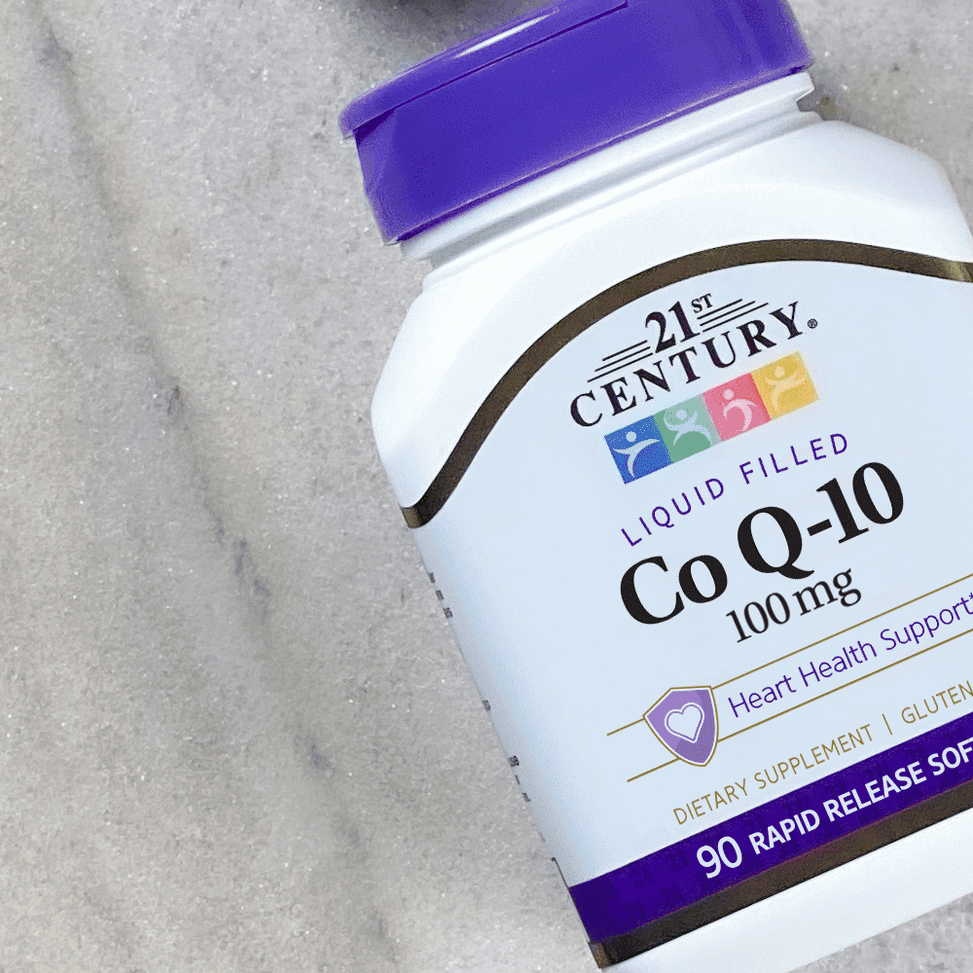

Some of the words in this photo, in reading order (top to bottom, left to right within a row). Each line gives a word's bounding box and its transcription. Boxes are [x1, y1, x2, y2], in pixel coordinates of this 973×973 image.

[620, 555, 728, 624] Co
[737, 462, 904, 579] Q-10
[621, 478, 724, 546] LIQUID
[739, 434, 847, 484] FILLED
[726, 592, 790, 643] 100
[792, 568, 861, 616] mg
[728, 675, 796, 717] Heart
[798, 641, 877, 687] Health
[673, 778, 748, 825] DIETARY
[754, 724, 872, 789] SUPPLEMENT
[902, 681, 973, 723] GLUTEN
[697, 836, 742, 878] 90
[749, 810, 820, 854] RAPID
[823, 761, 927, 822] RELEASE
